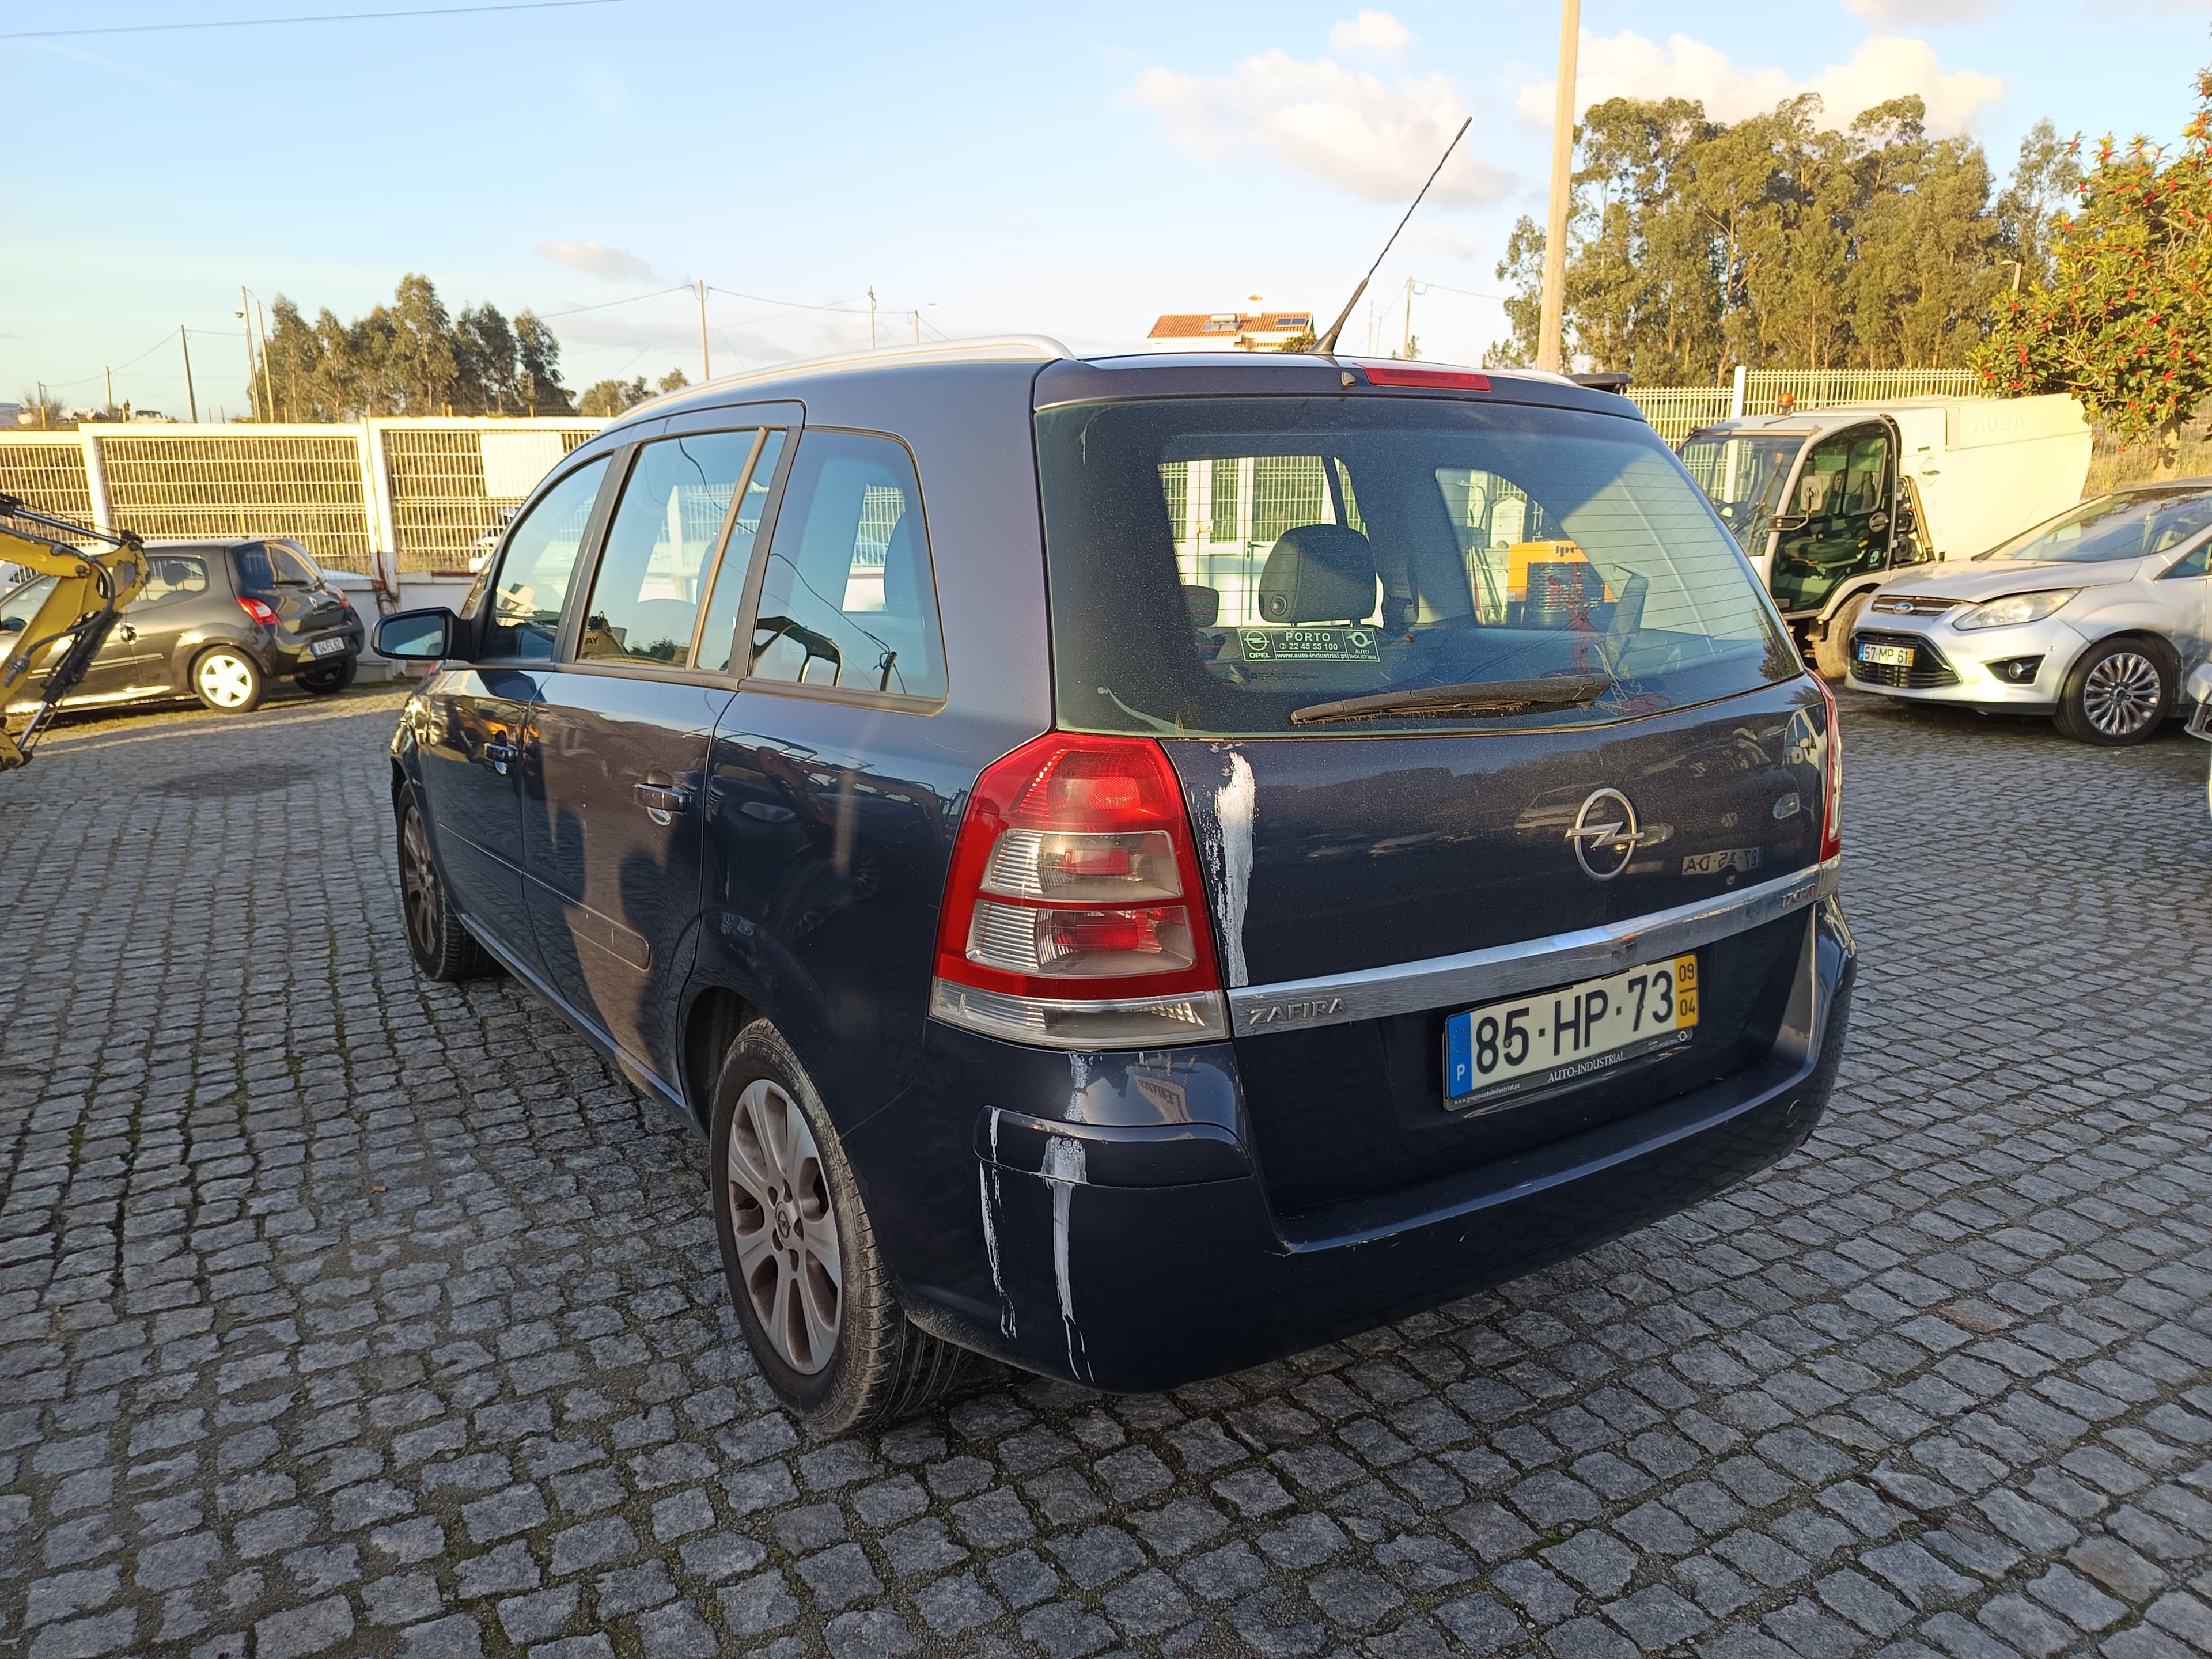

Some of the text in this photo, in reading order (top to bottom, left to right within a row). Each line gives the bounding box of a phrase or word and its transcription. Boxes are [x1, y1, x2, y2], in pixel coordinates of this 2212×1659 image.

[1285, 632, 1331, 642] PORTO
[1289, 642, 1299, 650] 22
[1679, 963, 1695, 981] 09
[1249, 997, 1350, 1025] ZAFIRA
[1679, 997, 1696, 1016] 04
[1456, 1063, 1465, 1081] P
[1548, 1051, 1626, 1083] AUTO-INDUSTRIAL
